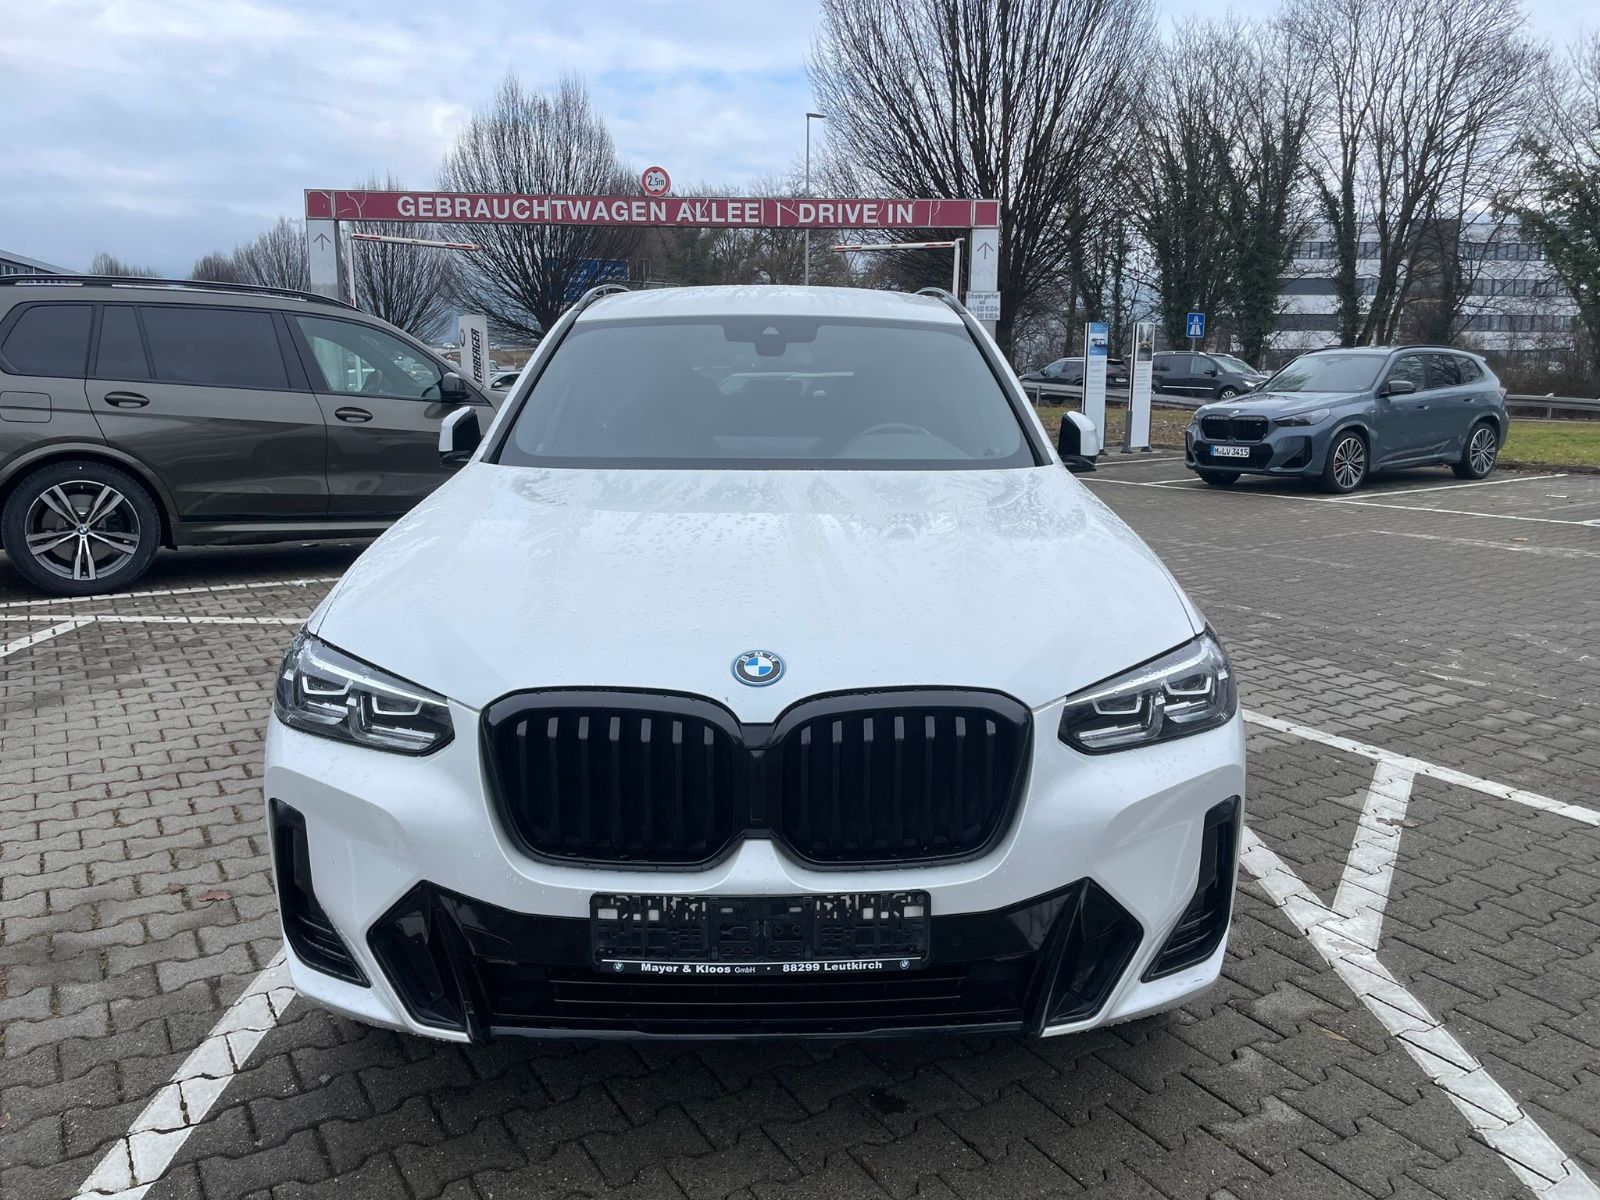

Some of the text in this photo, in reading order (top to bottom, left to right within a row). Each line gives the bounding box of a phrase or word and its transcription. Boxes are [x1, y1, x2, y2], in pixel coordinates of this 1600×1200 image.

[397, 195, 913, 224] GEBRAUCHTWAGEN ALLEE DRIVE IN
[1231, 448, 1249, 457] 3415
[741, 651, 778, 662] BMW
[641, 961, 883, 974] Mayer & Kloos GmbH 88299 Leutkirch
